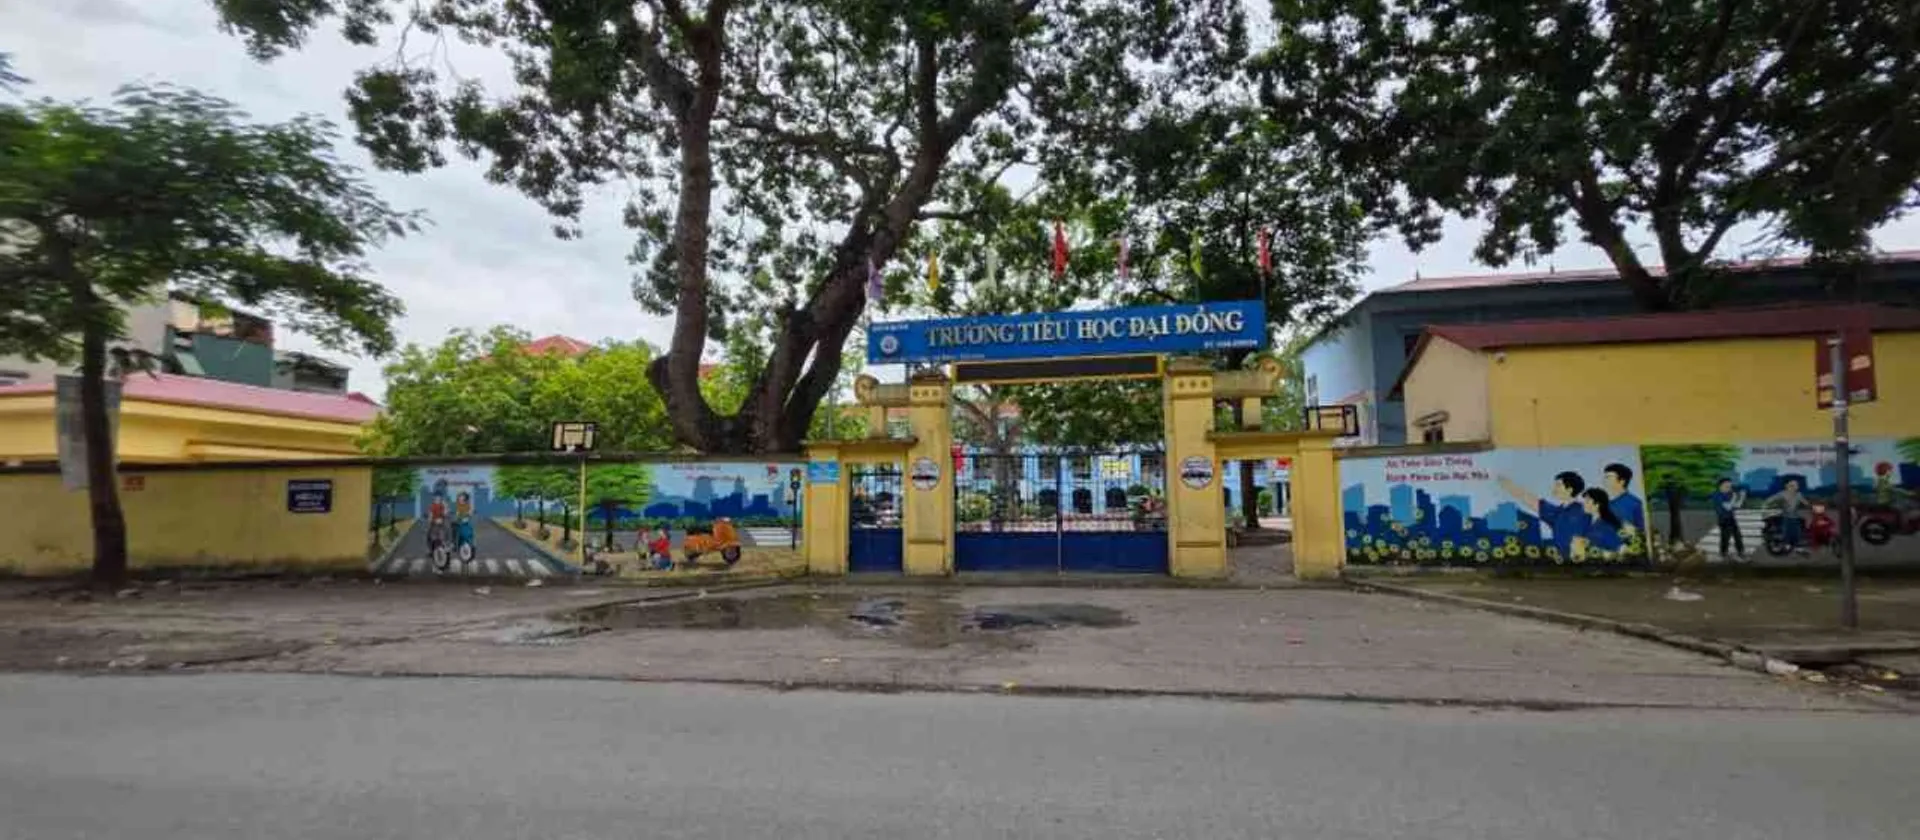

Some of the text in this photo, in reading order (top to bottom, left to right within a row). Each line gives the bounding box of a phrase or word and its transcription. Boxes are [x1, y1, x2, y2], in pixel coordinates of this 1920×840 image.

[1078, 317, 1125, 343] HỌC
[1129, 314, 1170, 342] ĐẠI
[1175, 305, 1244, 334] ĐỒNG
